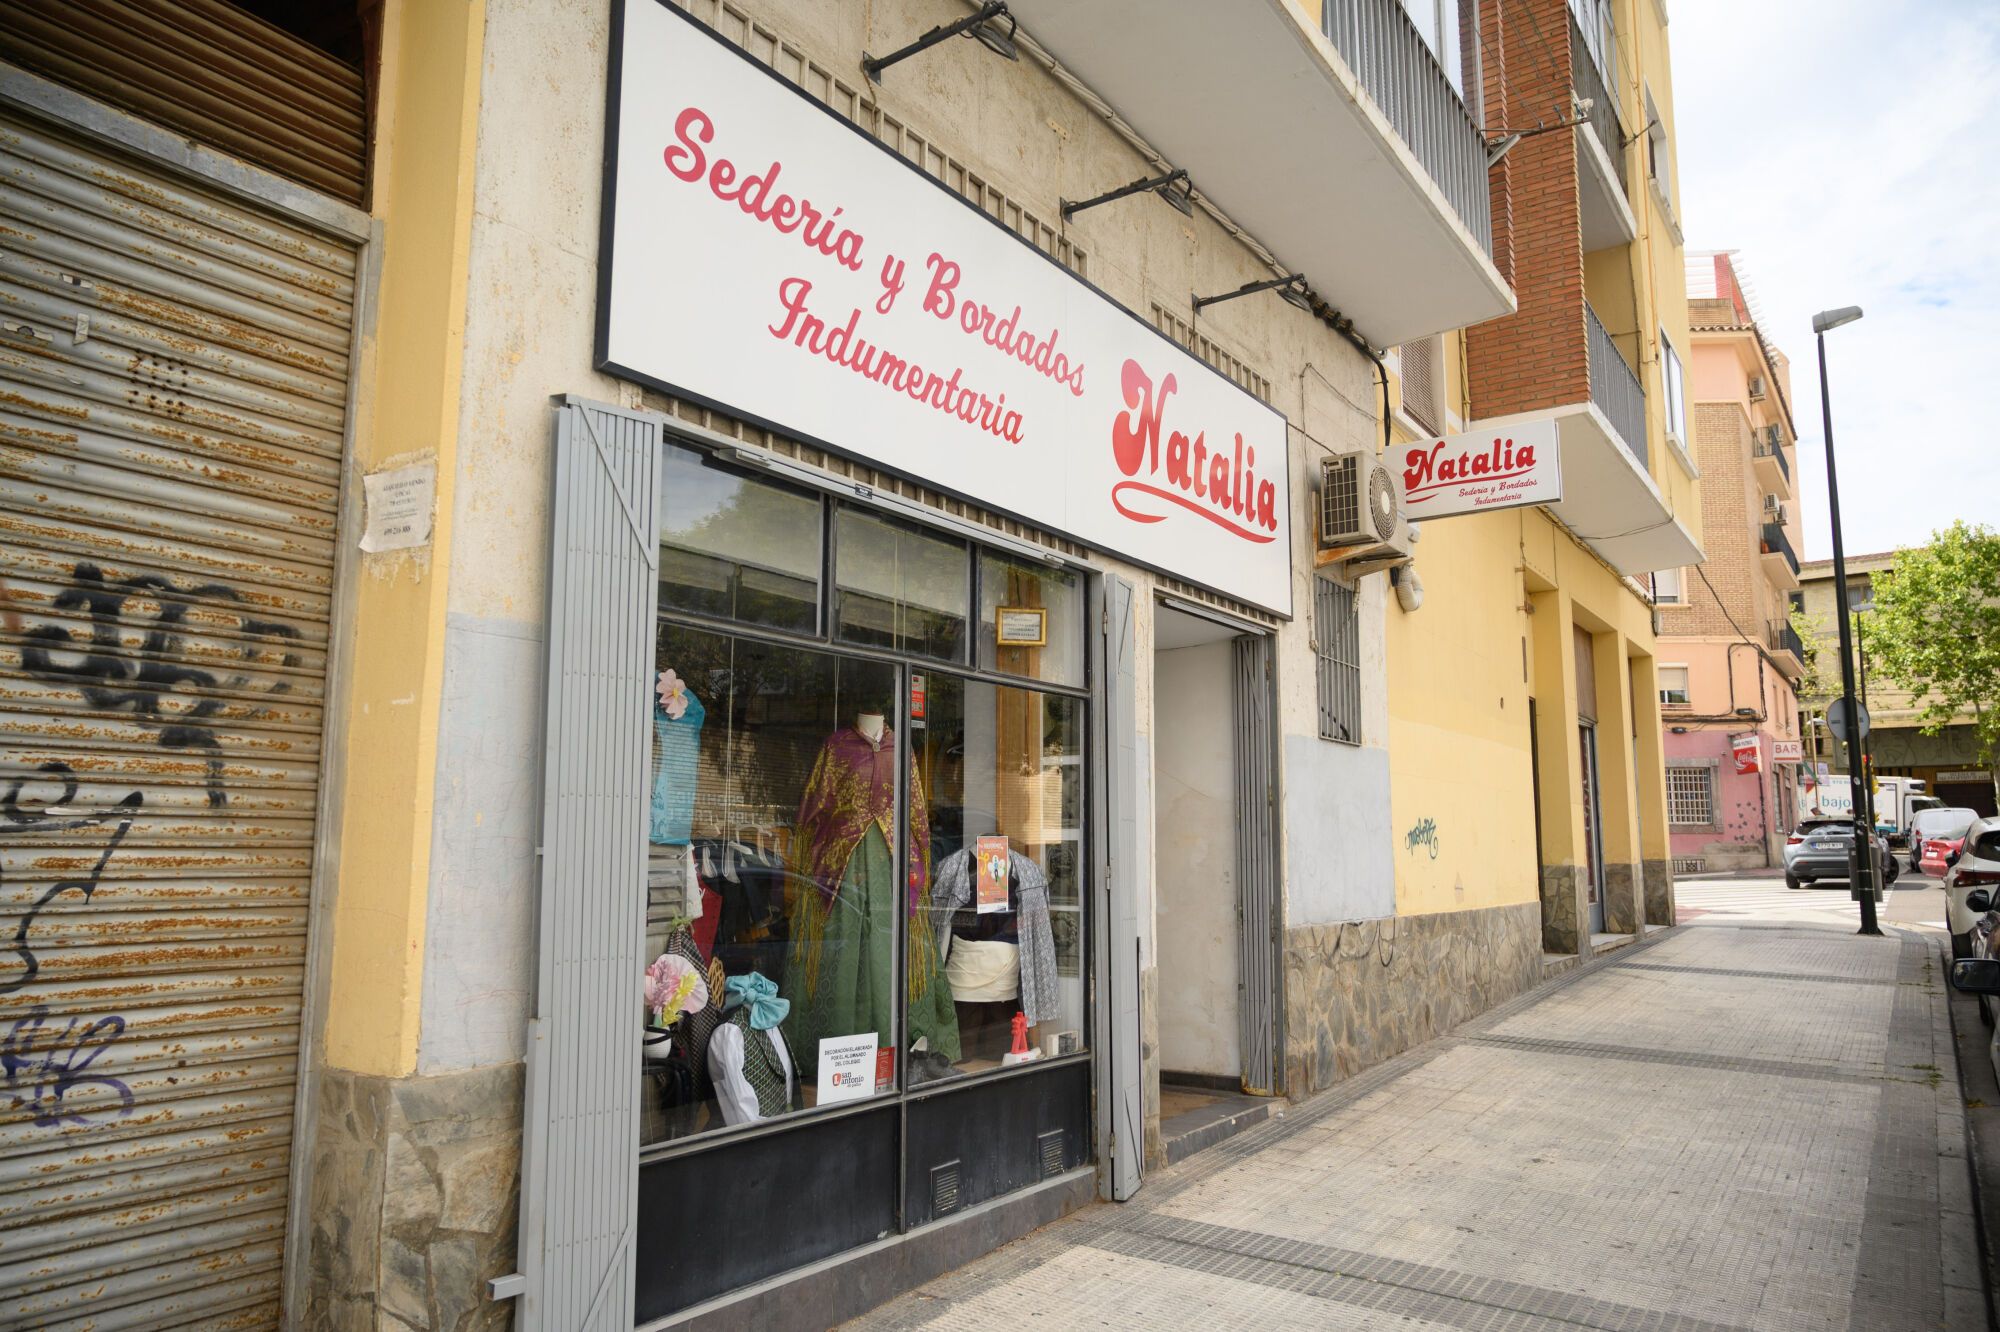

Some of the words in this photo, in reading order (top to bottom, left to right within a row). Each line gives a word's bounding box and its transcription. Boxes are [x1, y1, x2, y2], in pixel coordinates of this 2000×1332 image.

[663, 107, 864, 272] Sedería
[876, 255, 905, 315] y
[923, 253, 1085, 397] Bordados
[768, 277, 1024, 446] Indumentaria
[1112, 358, 1278, 533] Natalia
[1403, 438, 1536, 490] Natalia
[1474, 493, 1522, 505] Indumentaria
[1491, 486, 1496, 496] y
[1499, 479, 1537, 490] Bordados
[1775, 744, 1799, 754] BAR
[841, 1075, 865, 1085] antonio
